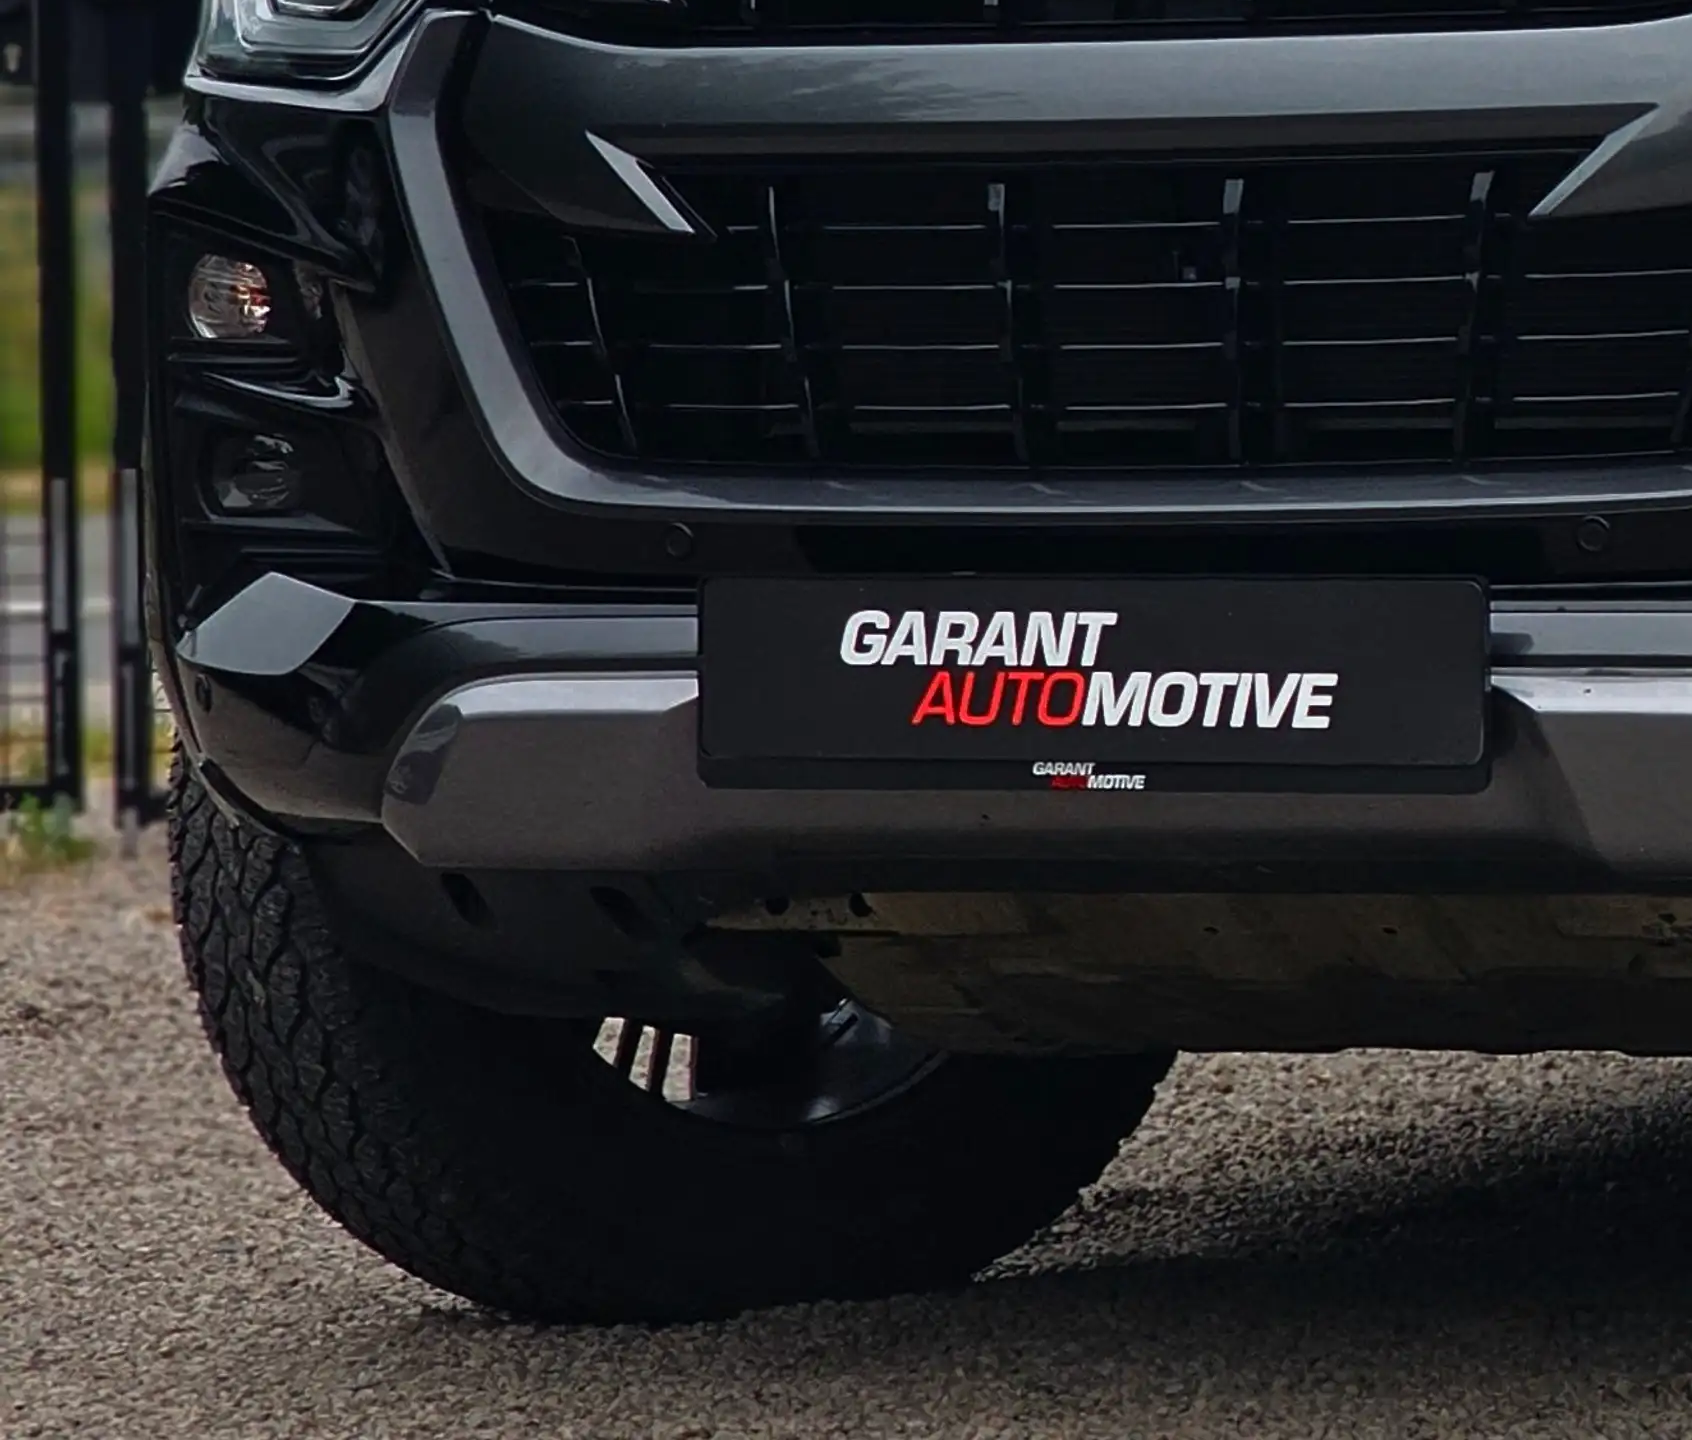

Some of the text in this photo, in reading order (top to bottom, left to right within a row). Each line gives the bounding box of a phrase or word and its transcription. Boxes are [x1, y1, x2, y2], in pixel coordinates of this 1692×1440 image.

[839, 610, 1118, 667] GARANT
[912, 670, 1339, 729] AUTOMOTIVE
[1032, 762, 1095, 776] GARANT
[1051, 774, 1146, 790] MOTIVE
